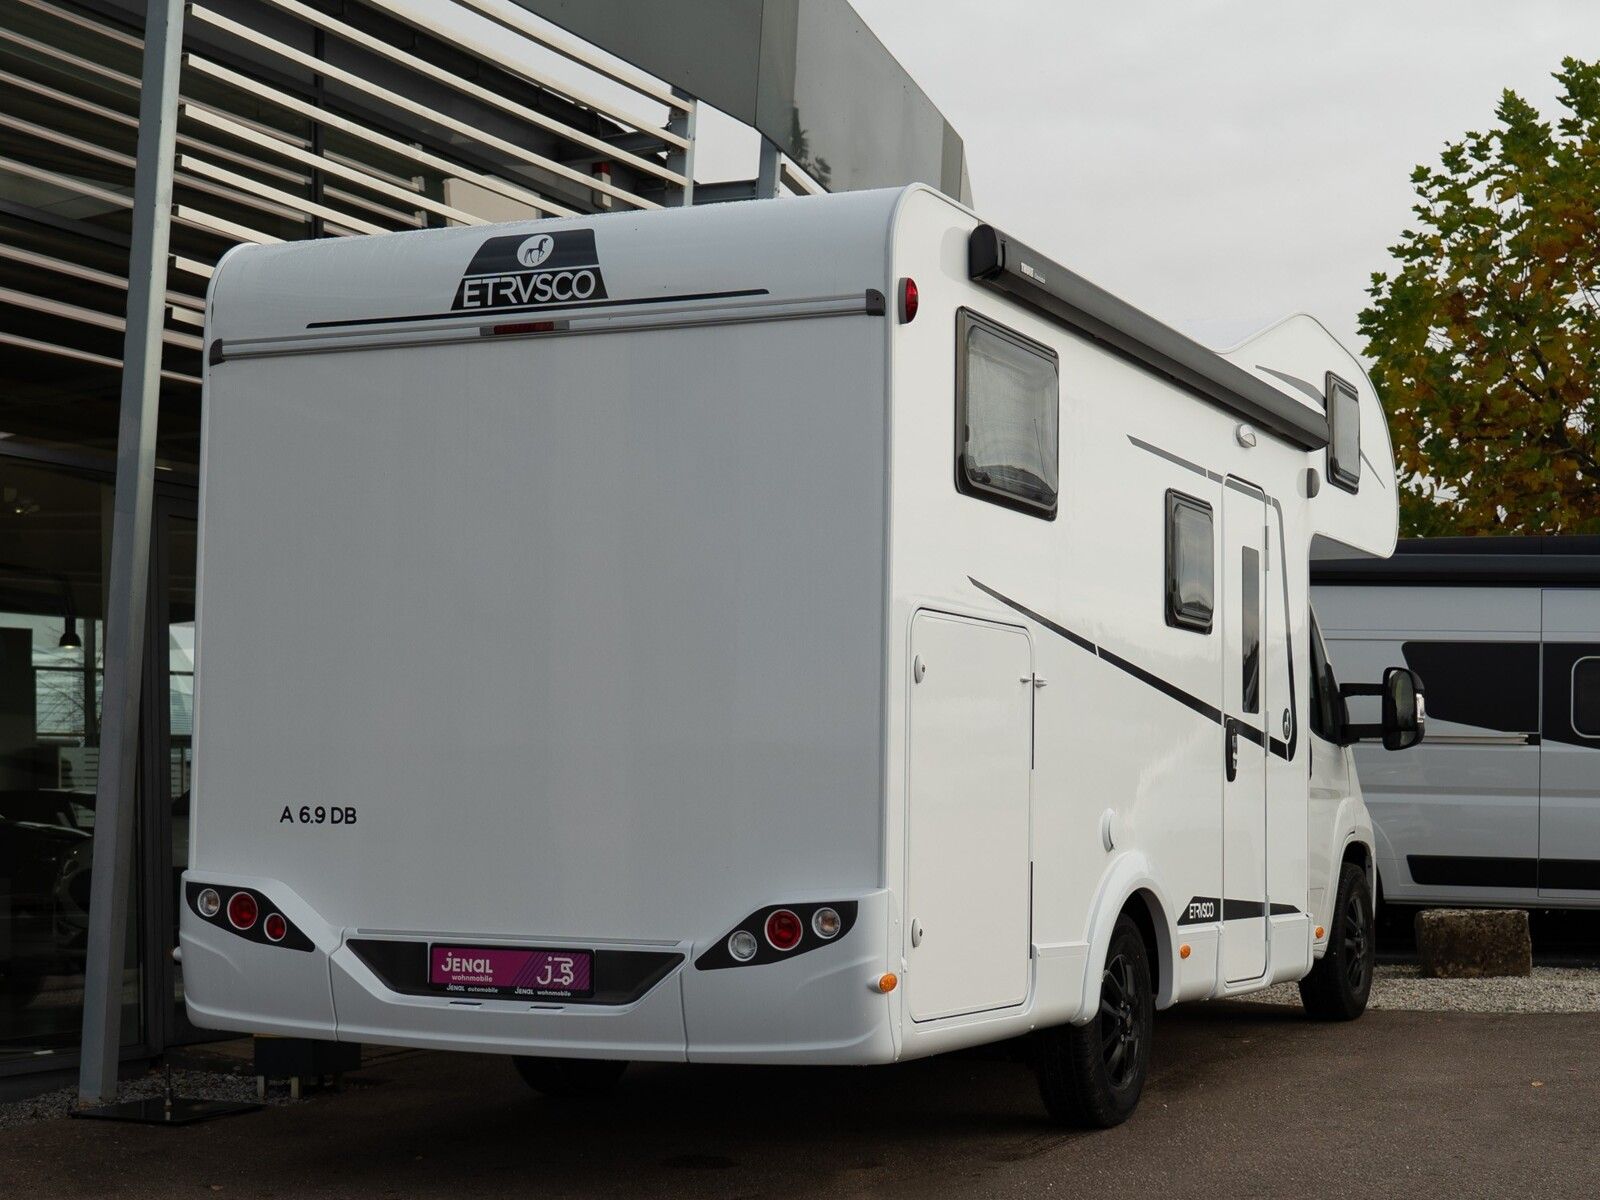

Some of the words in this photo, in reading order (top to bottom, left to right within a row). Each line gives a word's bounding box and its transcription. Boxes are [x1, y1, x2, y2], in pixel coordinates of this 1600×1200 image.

[280, 806, 294, 823] A
[299, 806, 326, 824] 6.9
[331, 806, 357, 824] DB
[452, 974, 493, 982] wohnmobile
